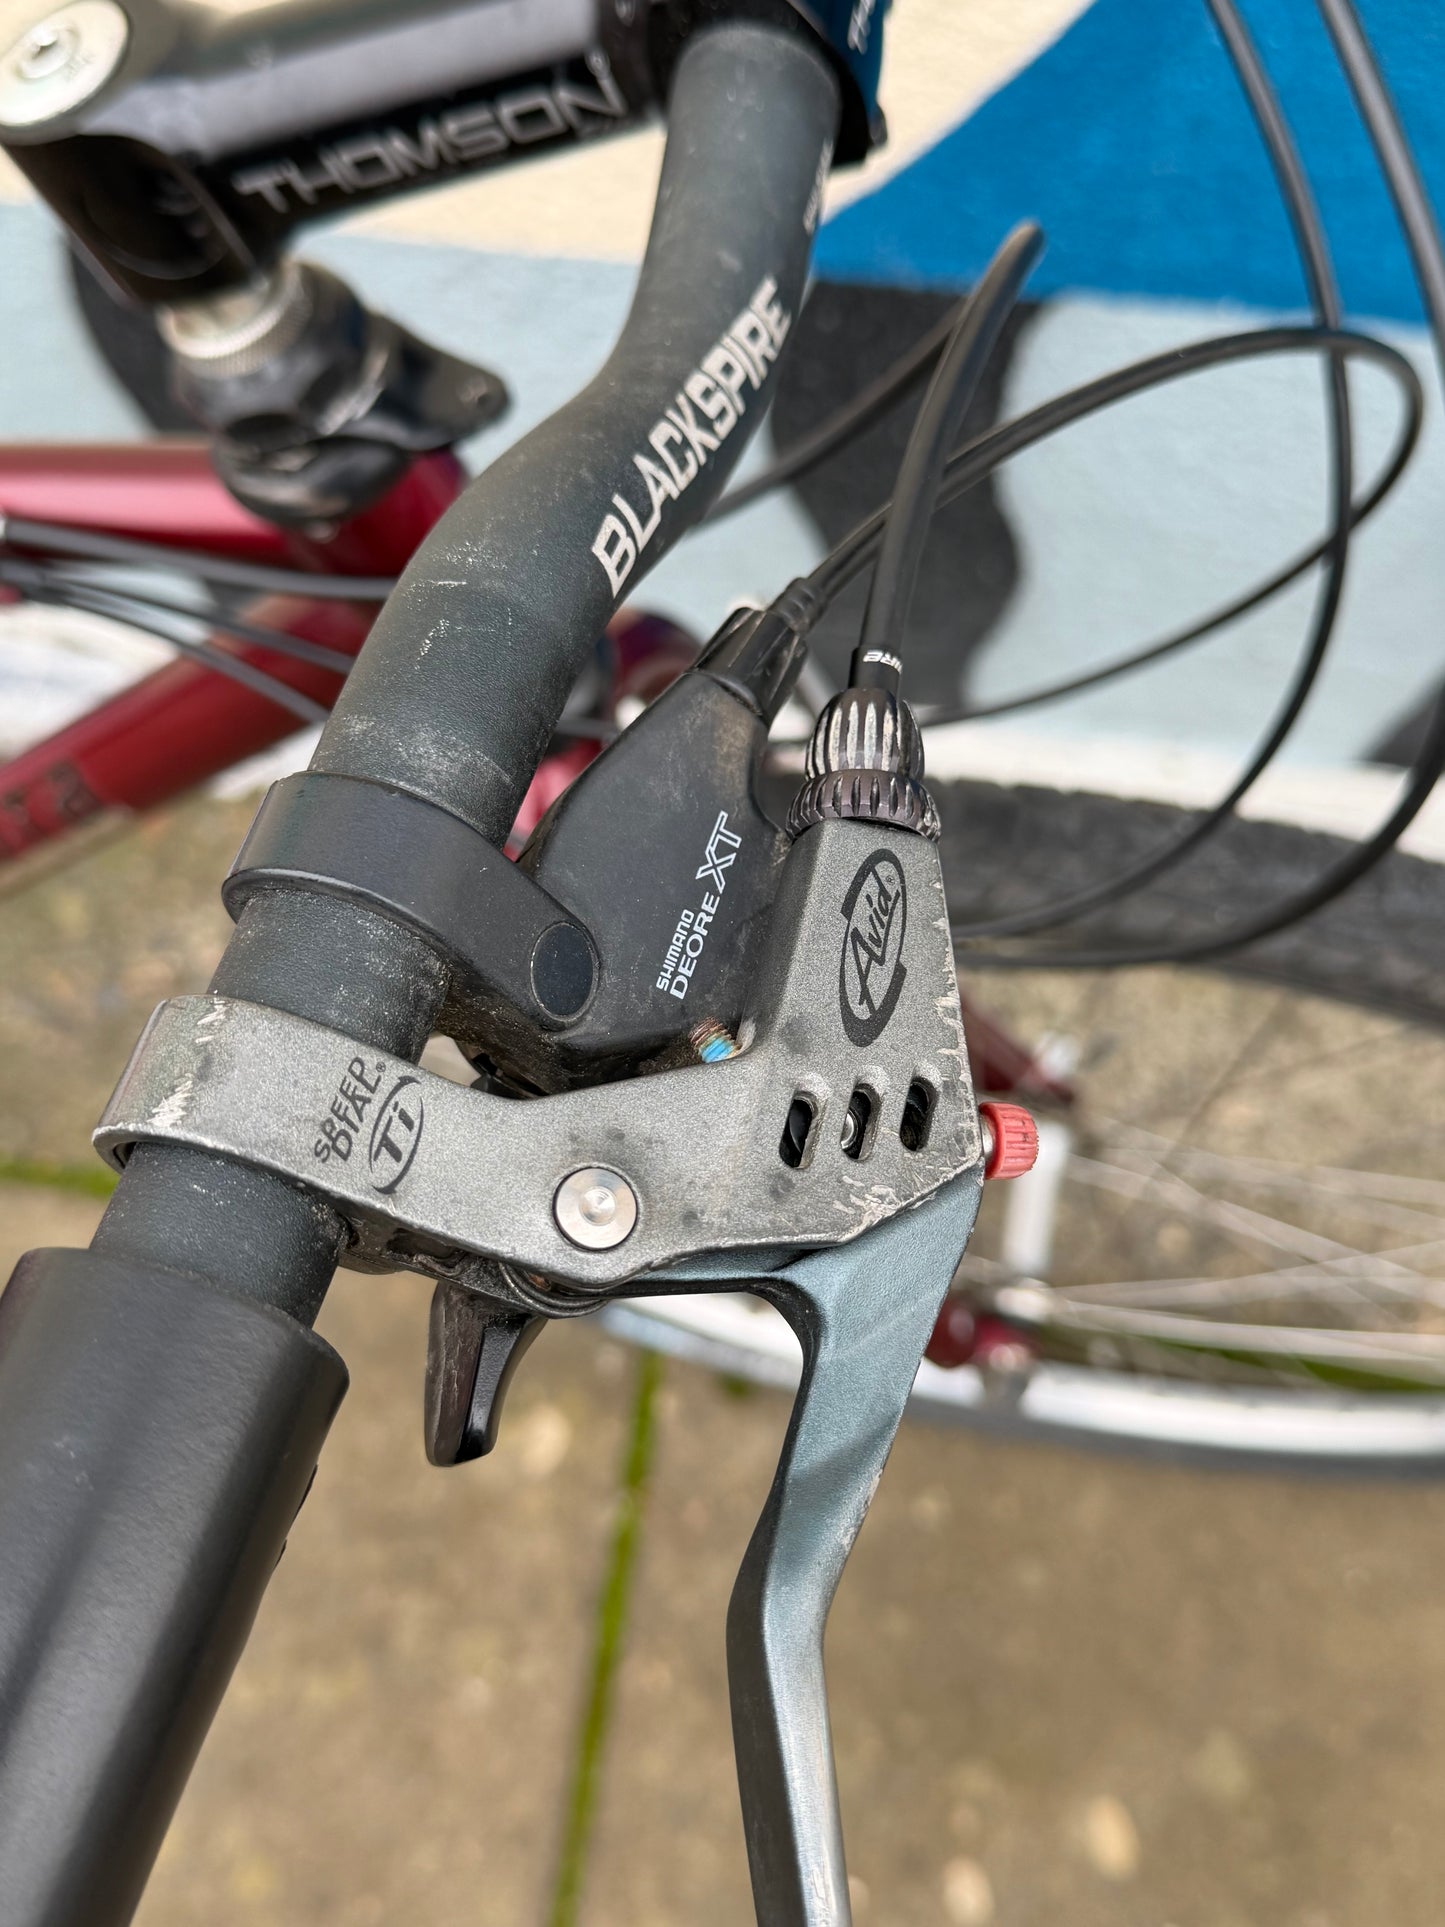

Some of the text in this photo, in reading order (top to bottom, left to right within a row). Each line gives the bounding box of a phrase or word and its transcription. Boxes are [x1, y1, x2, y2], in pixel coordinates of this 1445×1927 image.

[232, 72, 627, 213] THOMSON
[591, 274, 792, 599] BLACKSPIRE
[656, 909, 695, 982] SHIMANO
[670, 810, 742, 1000] DEORE XT
[314, 1056, 366, 1164] SPEED
[373, 1100, 415, 1163] Ti
